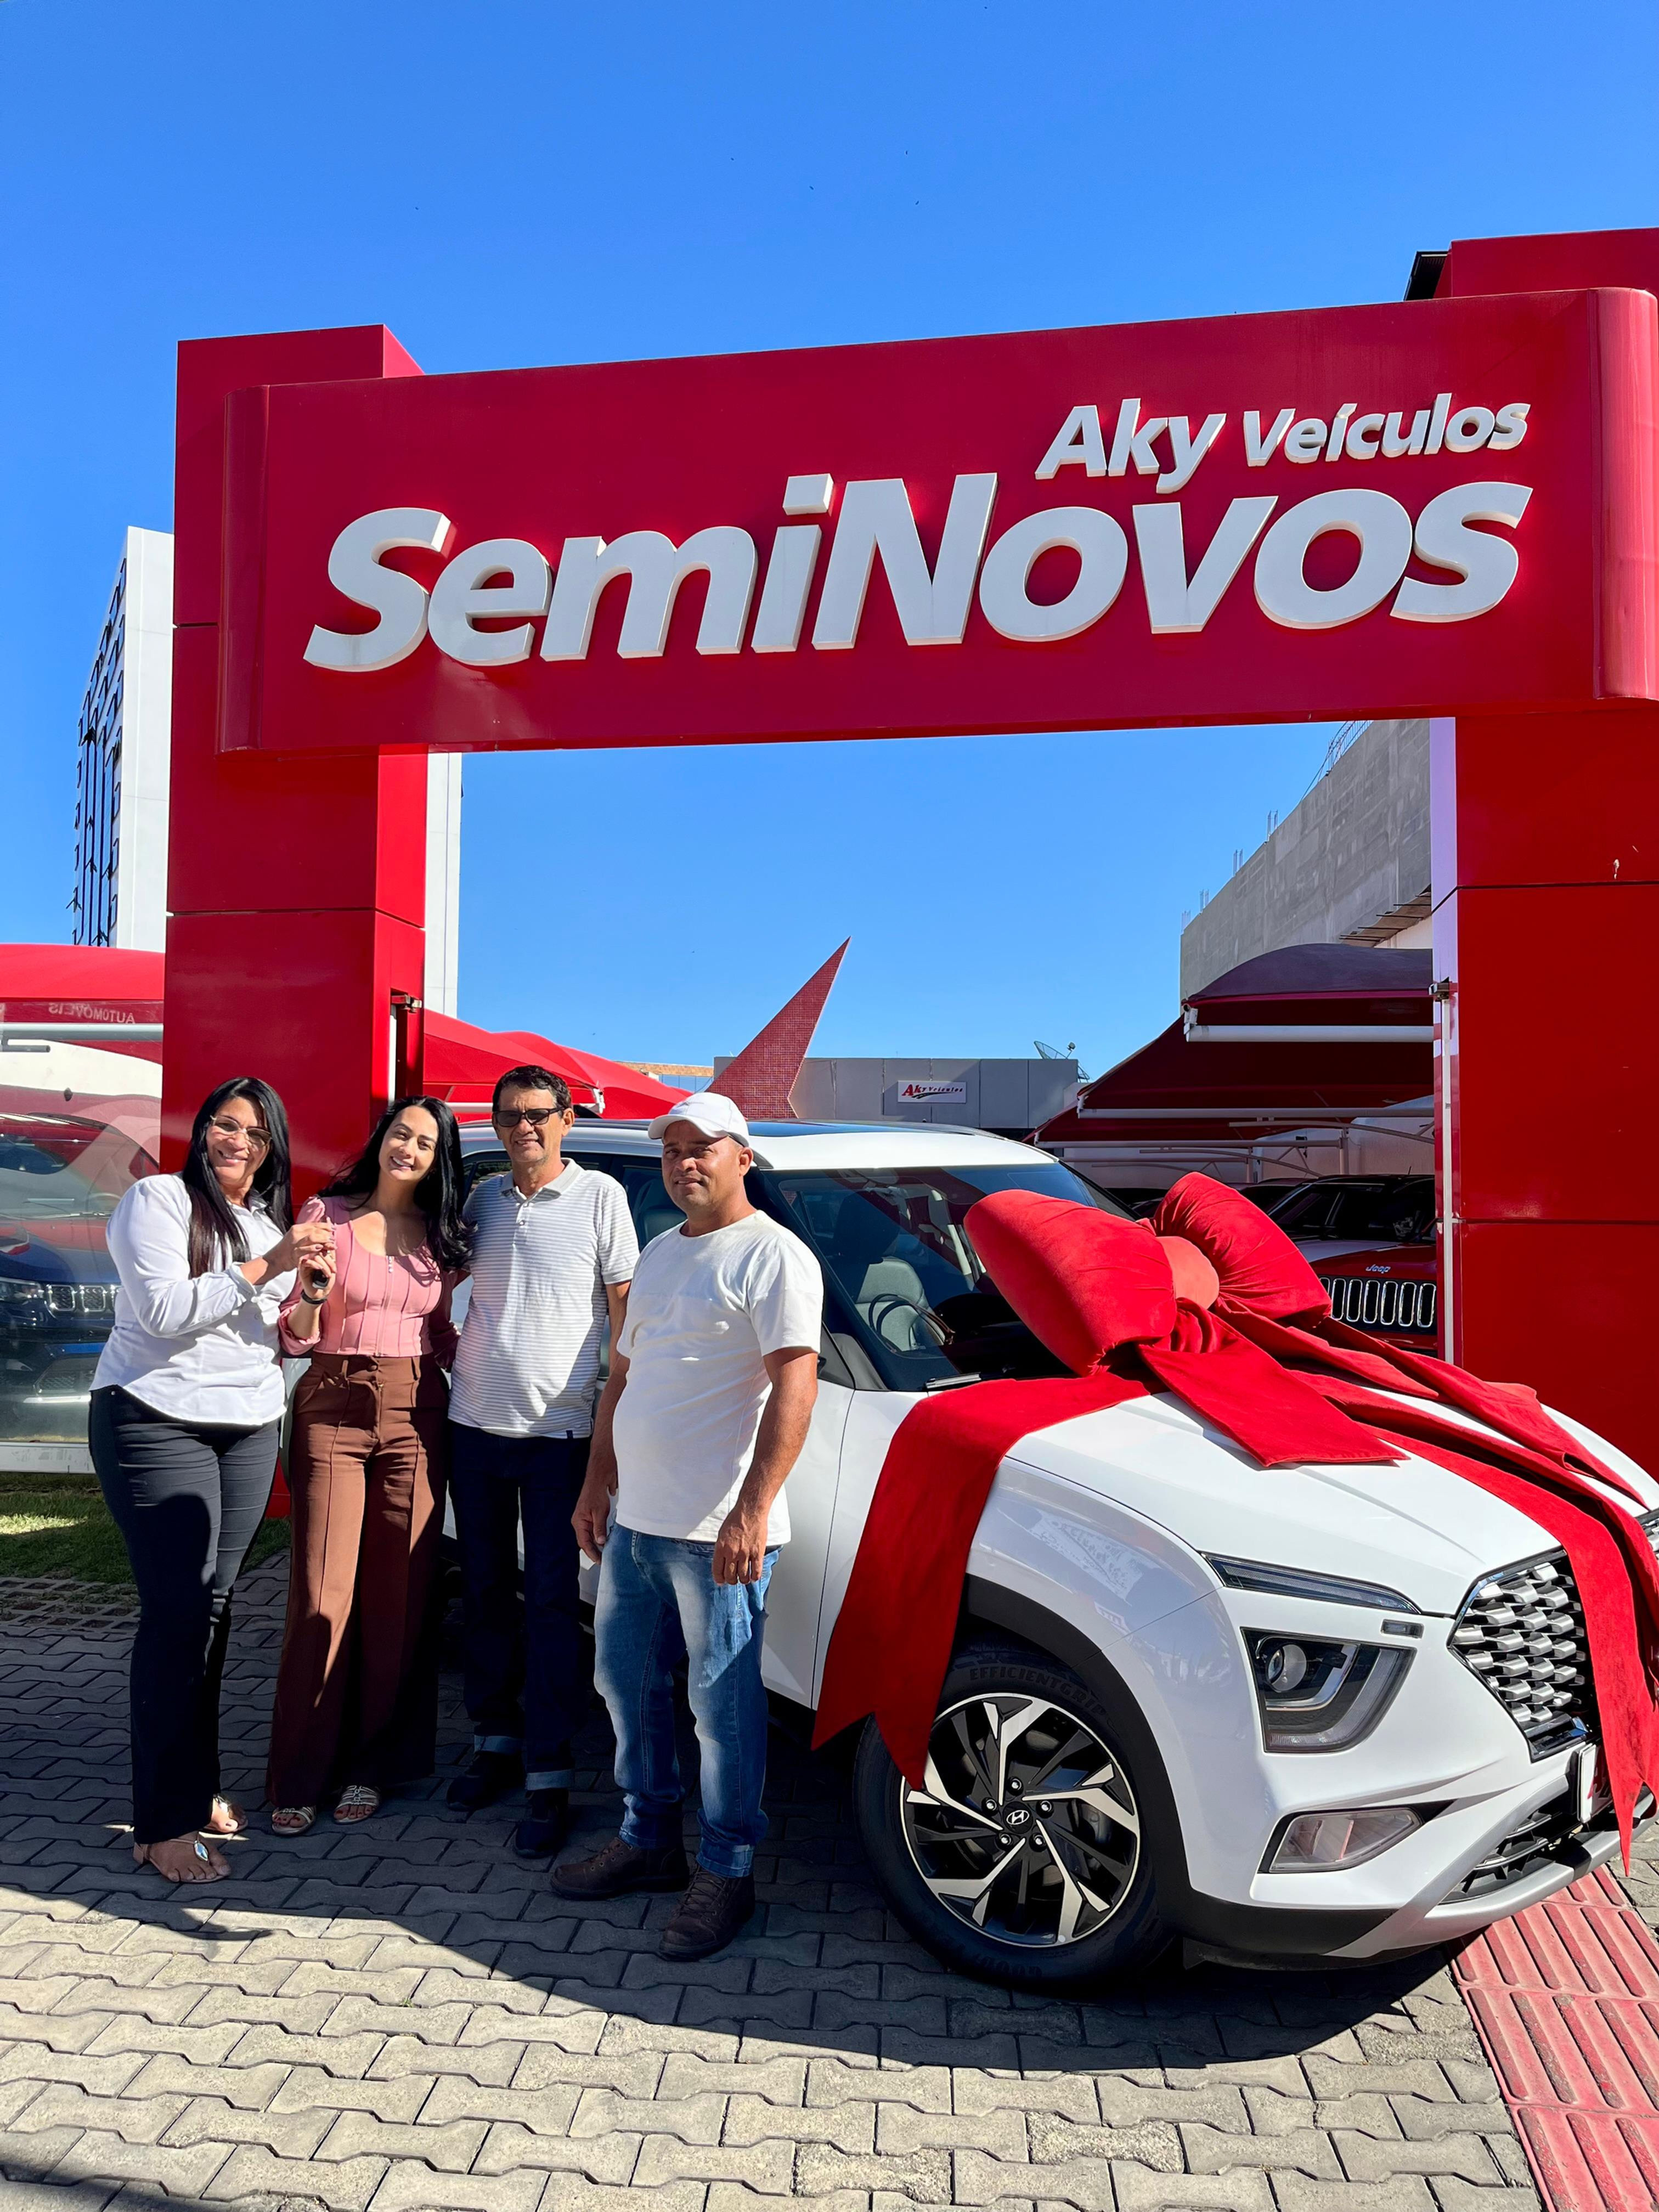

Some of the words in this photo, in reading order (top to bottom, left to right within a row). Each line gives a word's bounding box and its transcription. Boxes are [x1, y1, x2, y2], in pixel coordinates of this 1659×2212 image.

[1035, 398, 1227, 493] Aky
[1243, 393, 1531, 466] Veículos
[304, 472, 1533, 672] SemiNovos
[901, 1084, 927, 1096] Aky
[1365, 1264, 1391, 1274] Jeep
[969, 1666, 1107, 1716] EFFICIENTGRIP
